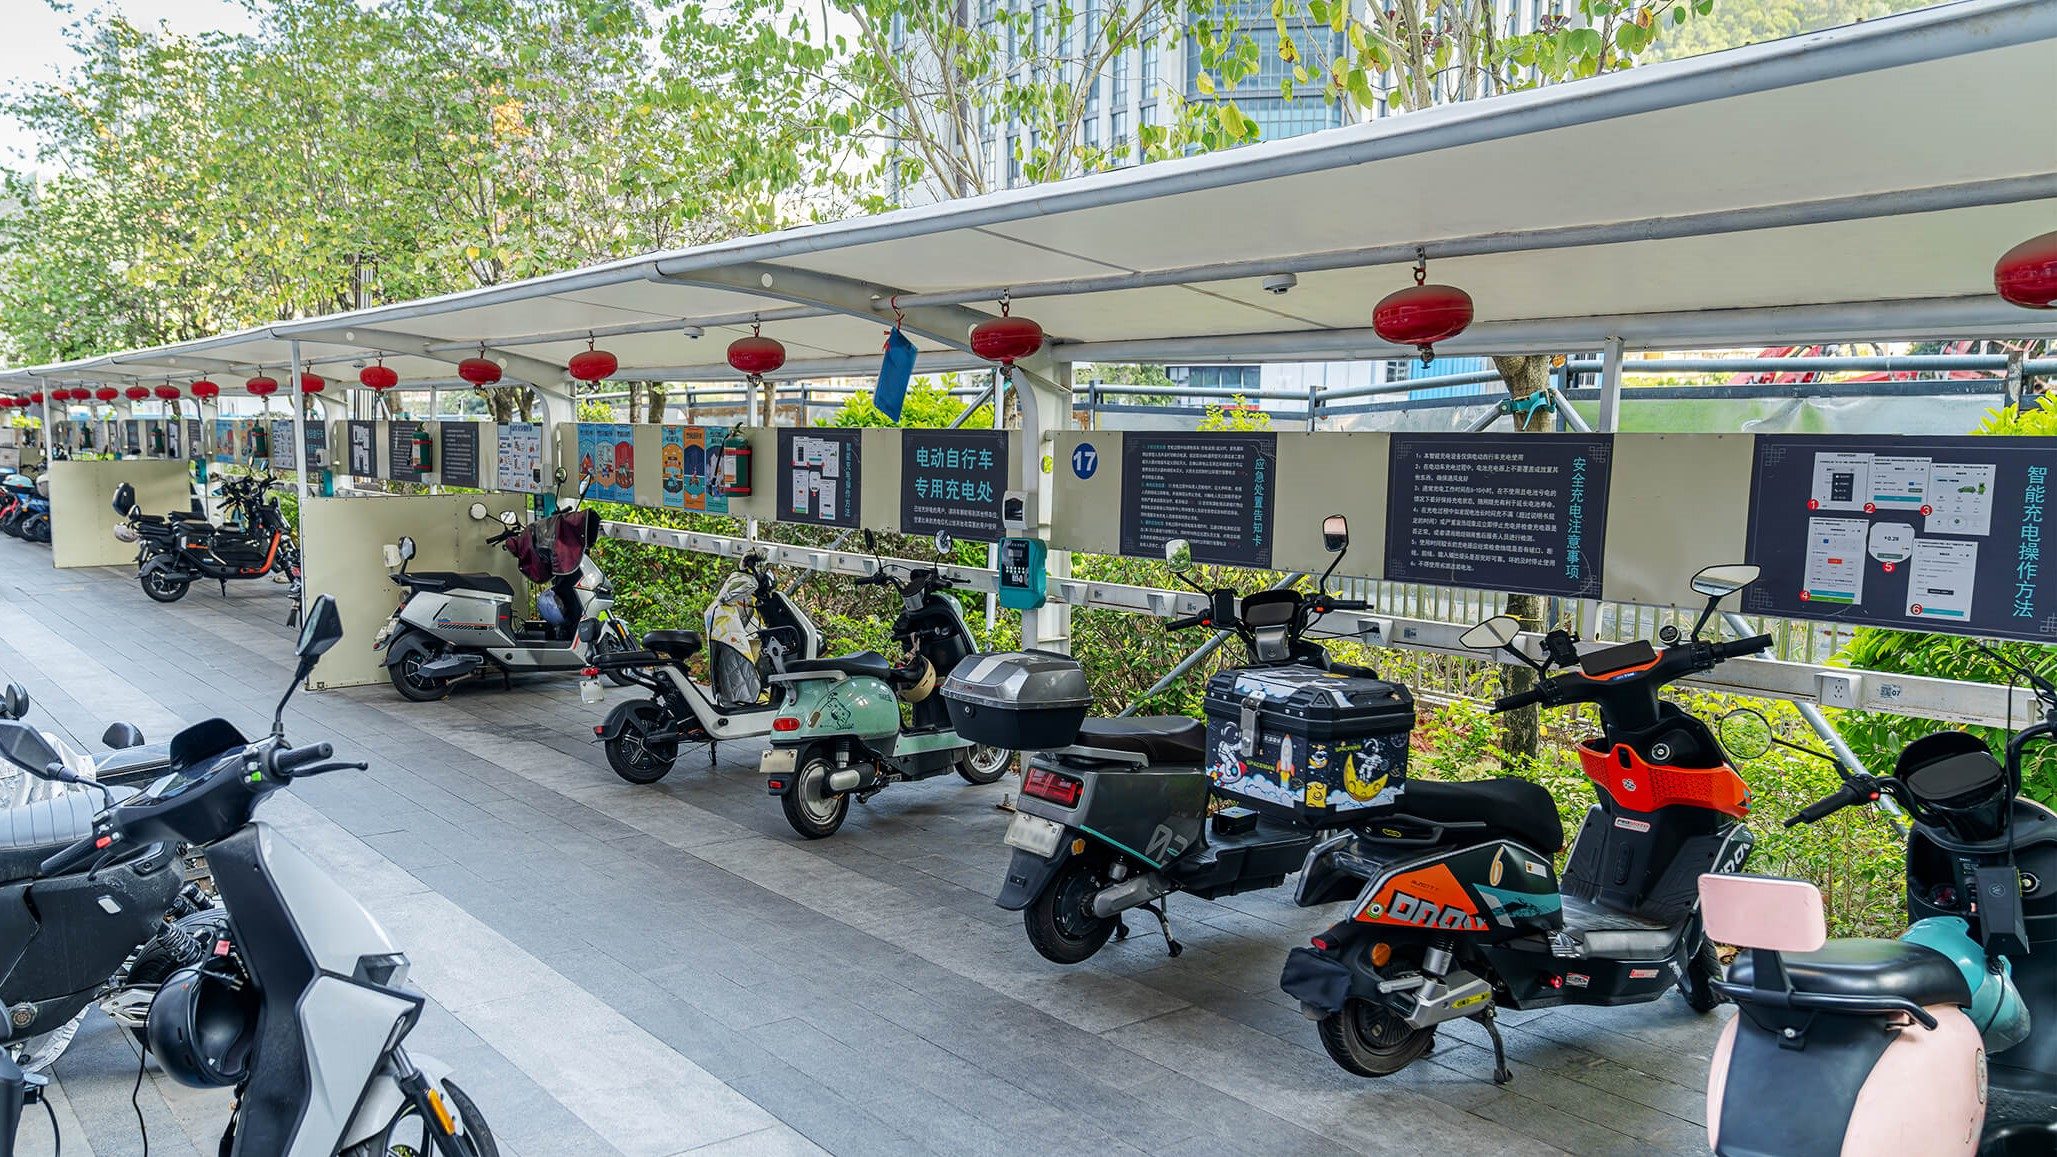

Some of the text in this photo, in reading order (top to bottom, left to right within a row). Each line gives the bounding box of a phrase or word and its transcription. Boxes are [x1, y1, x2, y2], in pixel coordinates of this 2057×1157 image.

[915, 446, 994, 470] 电动自行车
[1073, 451, 1096, 471] 17
[914, 476, 994, 503] 专用充电处
[1252, 458, 1265, 546] 应急处置告知卡
[1564, 456, 1586, 579] 安全充电注意事项
[2013, 465, 2048, 618] 智能充电操作方法
